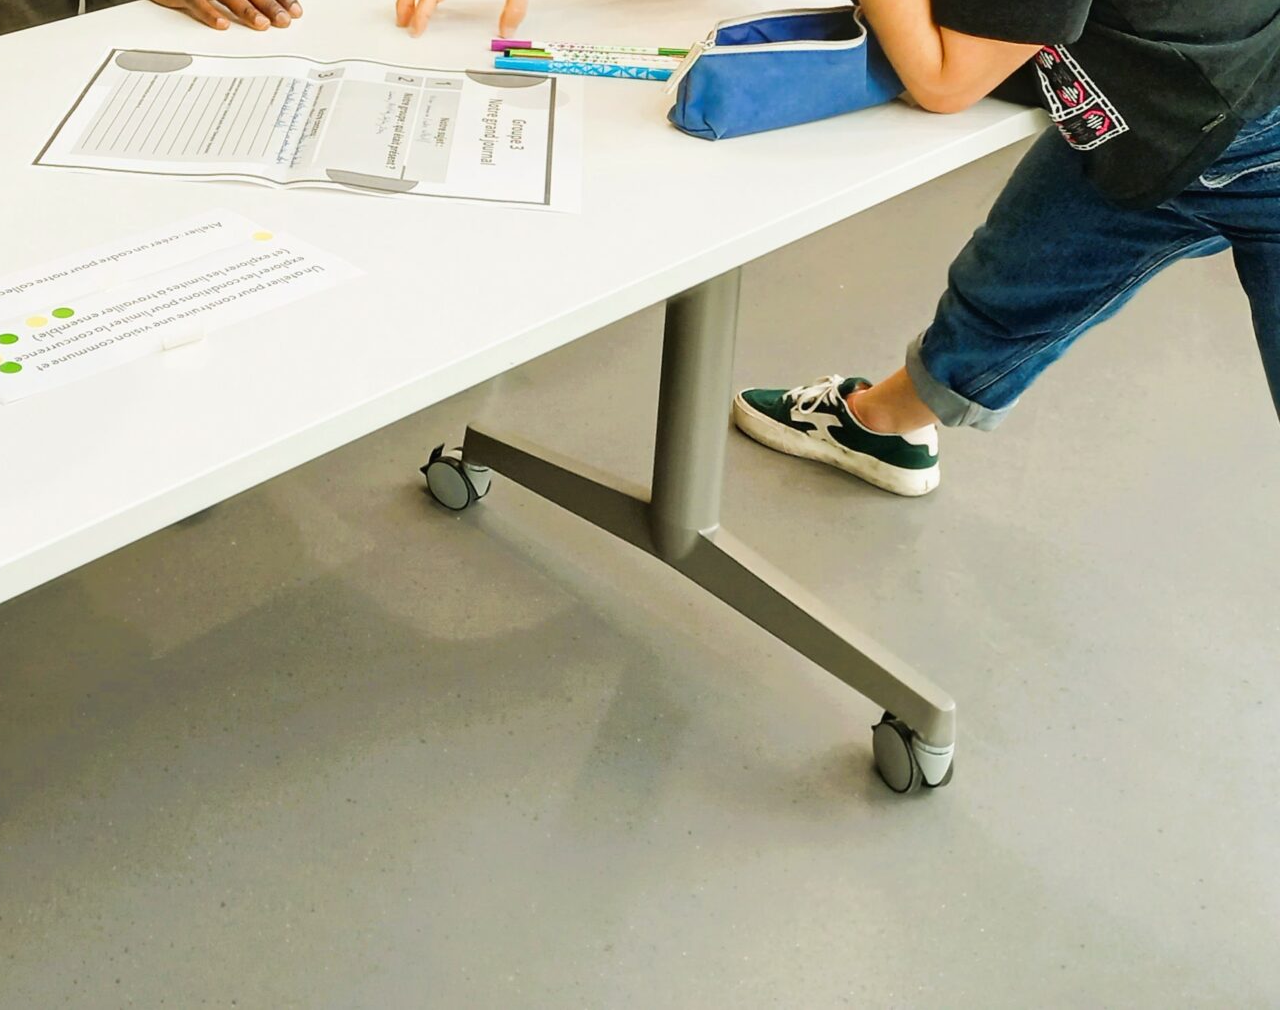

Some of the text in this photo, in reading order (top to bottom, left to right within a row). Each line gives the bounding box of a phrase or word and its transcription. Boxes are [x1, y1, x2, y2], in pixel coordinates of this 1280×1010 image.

[437, 117, 450, 132] Notre
[478, 98, 503, 166] Notre grand journal
[507, 119, 527, 145] Groupe
[99, 250, 133, 264] cadre
[132, 245, 150, 253] un
[70, 260, 99, 274] pour
[224, 254, 271, 273] explorer
[36, 271, 69, 284] notre
[205, 270, 228, 278] les
[165, 275, 211, 292] limites
[14, 256, 305, 362] explorer les conditions pour limiter la concurrence
[101, 293, 159, 316] travailler
[31, 313, 100, 342] ensemble)
[36, 265, 325, 372] Un atelier pour construire une vision commune et
